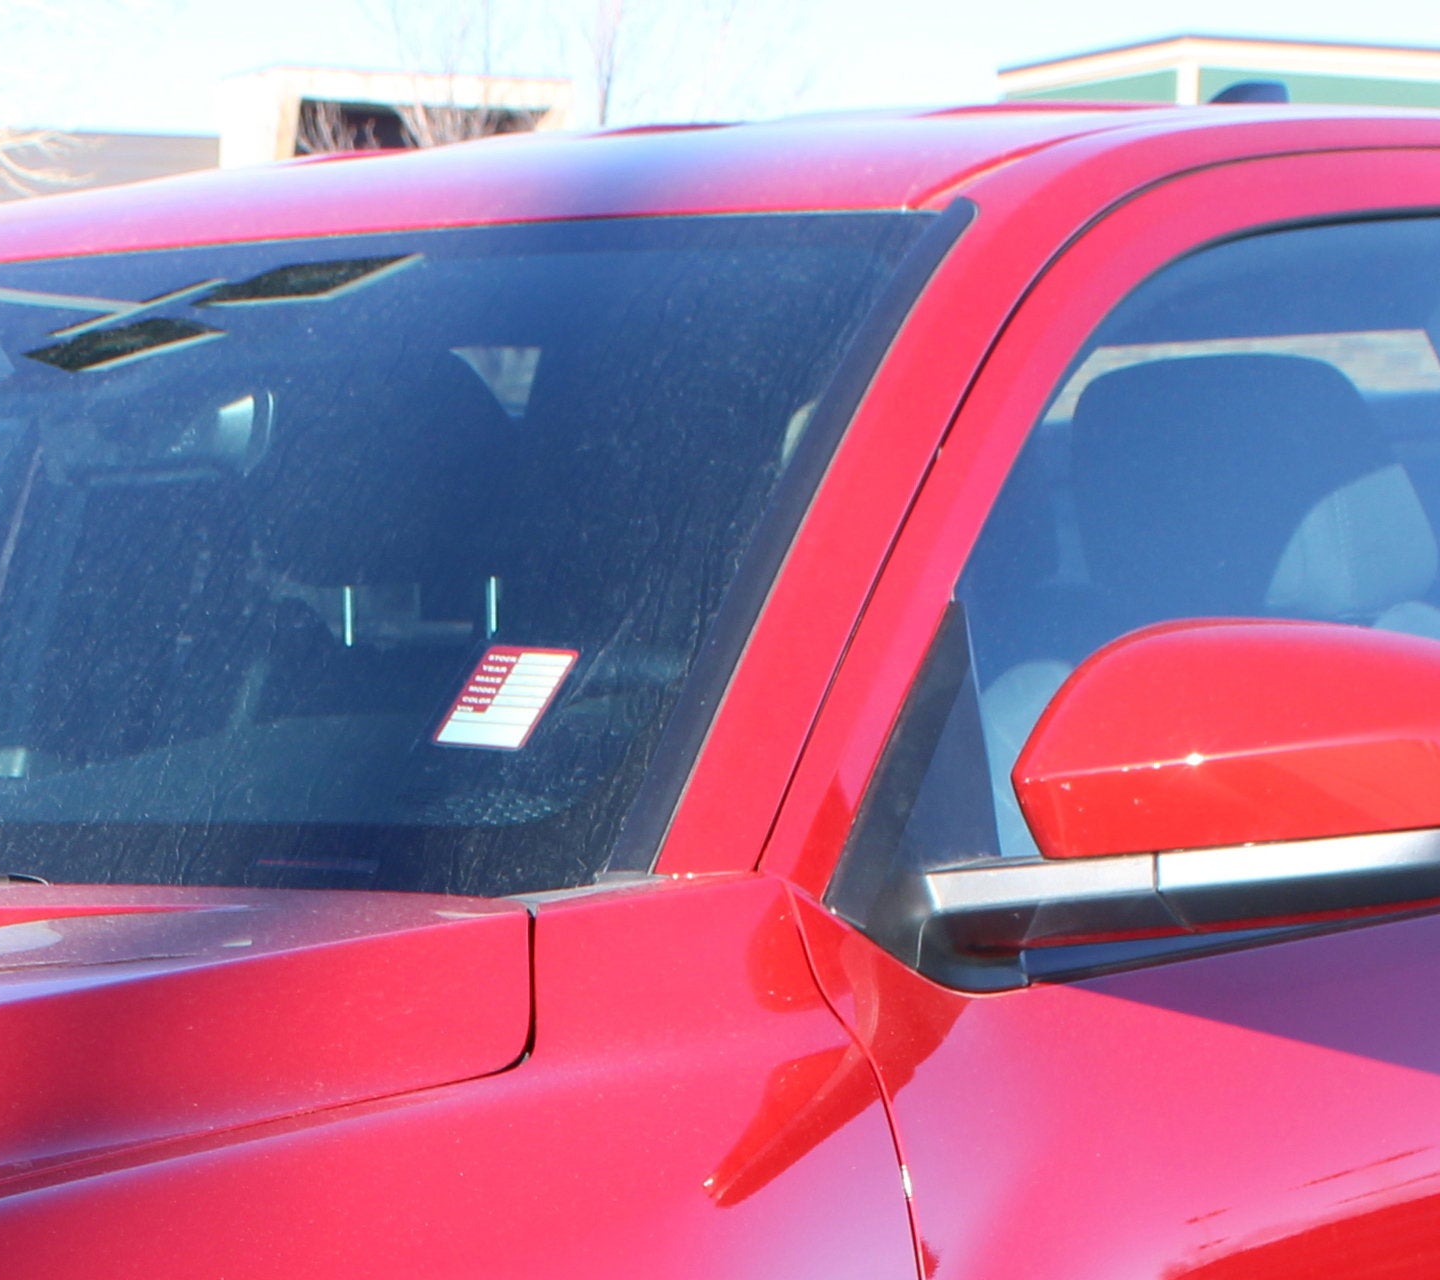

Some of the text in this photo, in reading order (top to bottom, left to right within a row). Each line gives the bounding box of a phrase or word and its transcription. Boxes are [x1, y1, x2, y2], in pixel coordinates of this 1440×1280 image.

[488, 653, 518, 663] STOCK
[482, 664, 508, 674] YEAR
[474, 675, 502, 684] MAKE
[468, 685, 497, 694] MODEL
[461, 696, 492, 705] COLOR
